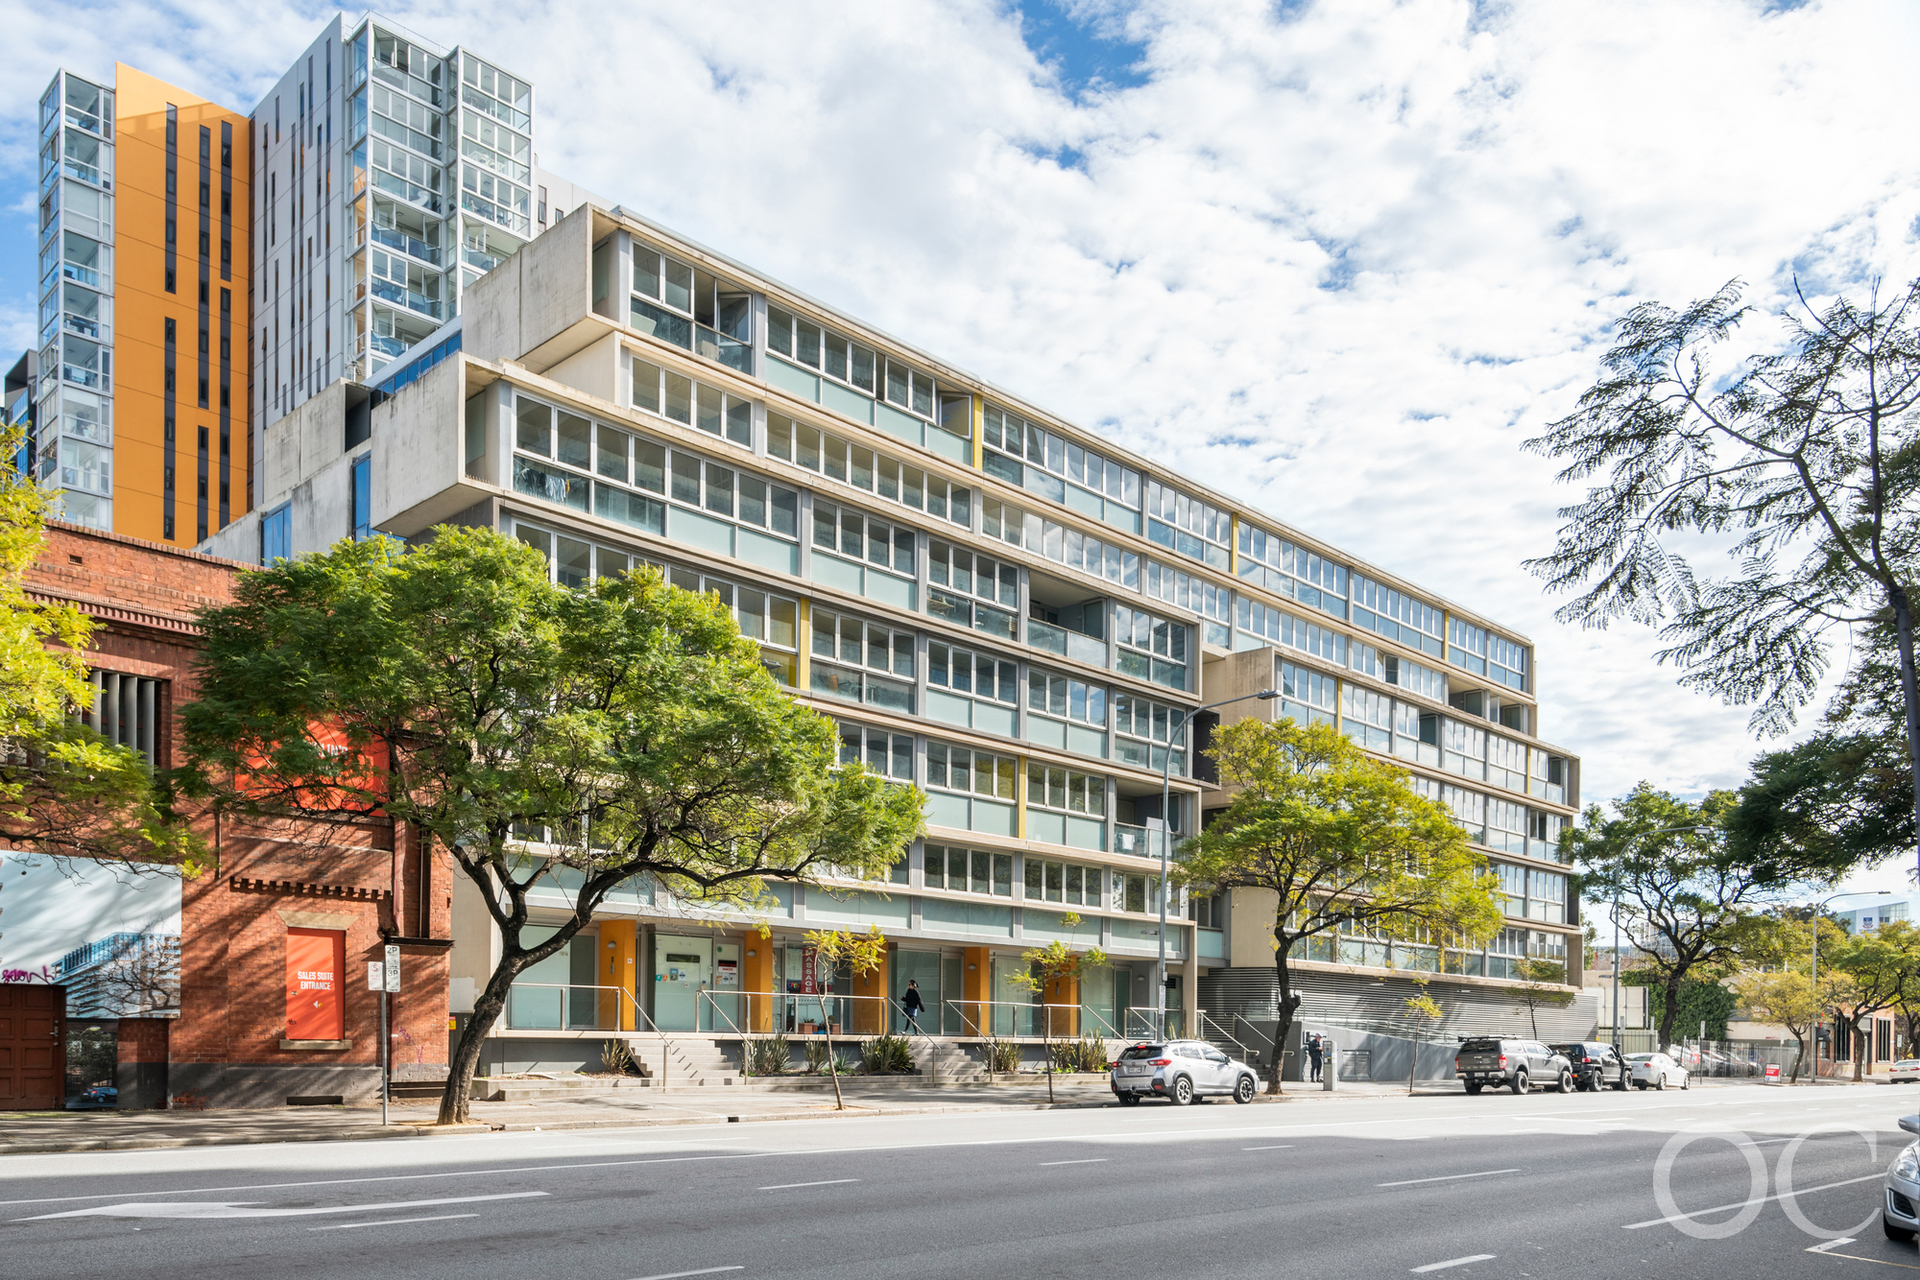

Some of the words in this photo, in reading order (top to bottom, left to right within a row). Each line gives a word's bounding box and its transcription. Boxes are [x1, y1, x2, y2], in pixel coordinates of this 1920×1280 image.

[297, 970, 317, 980] SALES
[317, 971, 334, 981] SUITE
[804, 950, 814, 993] MASSAGE
[300, 980, 331, 991] ENTRANCE
